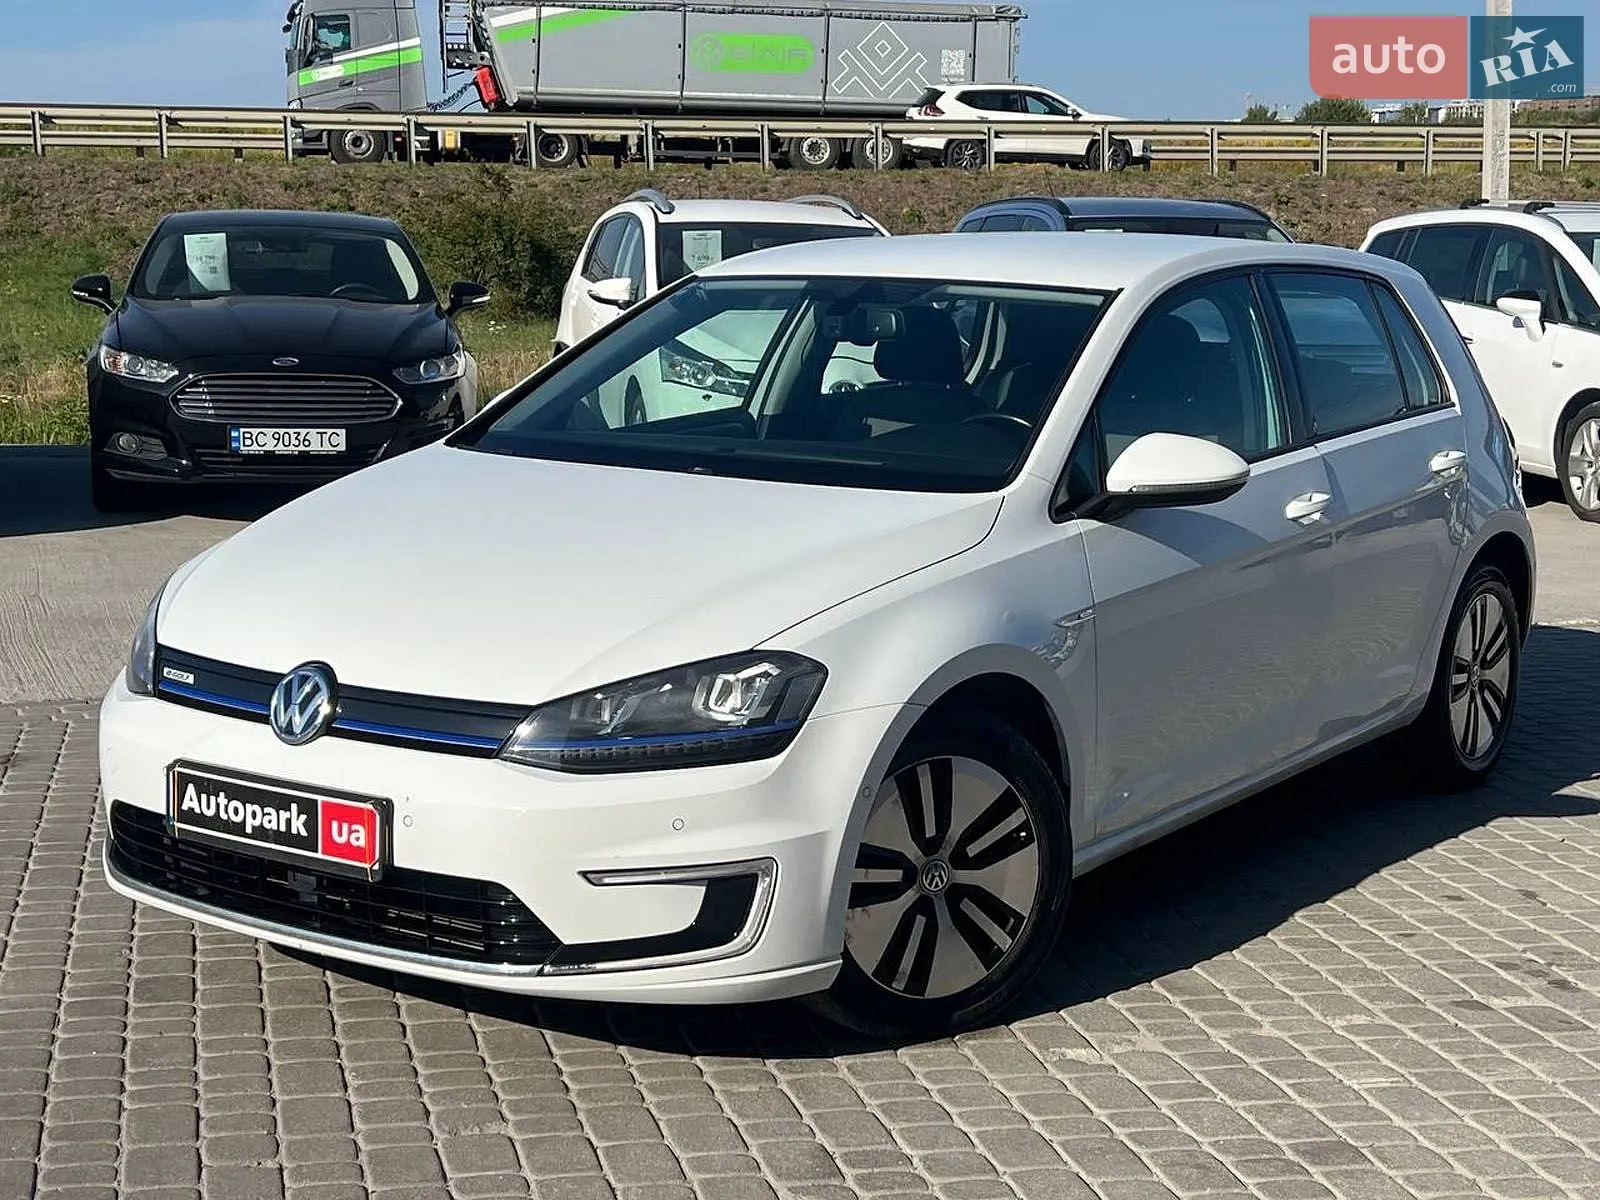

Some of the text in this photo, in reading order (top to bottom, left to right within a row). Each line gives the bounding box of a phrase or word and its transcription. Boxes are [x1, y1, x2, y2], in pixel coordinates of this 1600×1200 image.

[242, 431, 341, 448] BC 9036 TC
[181, 782, 367, 848] Autopark ua
